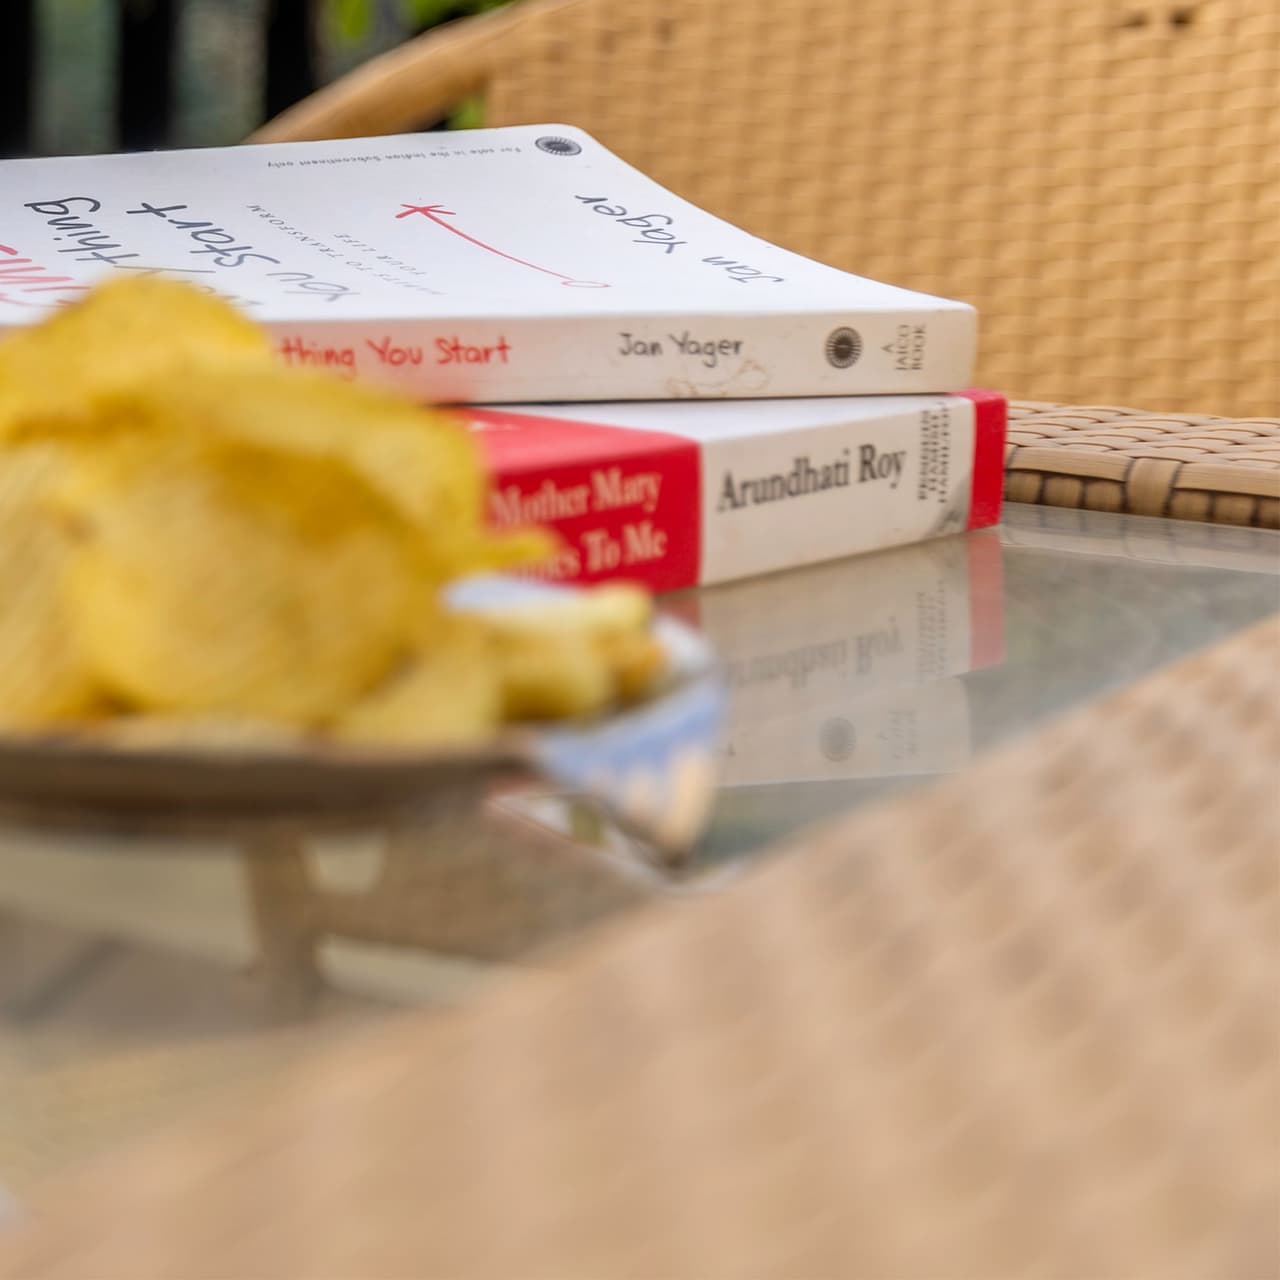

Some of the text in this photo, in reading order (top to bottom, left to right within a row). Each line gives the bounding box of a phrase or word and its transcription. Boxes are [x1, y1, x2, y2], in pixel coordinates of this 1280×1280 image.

[126, 202, 361, 303] You Start
[246, 204, 344, 258] TRANSFORM
[574, 194, 784, 283] Jan Yager
[365, 338, 424, 366] You
[436, 337, 511, 366] Start
[619, 331, 744, 368] Jan Yager
[490, 467, 663, 528] Mother Mary
[717, 444, 906, 512] Arundhati Roy
[579, 528, 621, 574] To
[622, 521, 668, 565] Me
